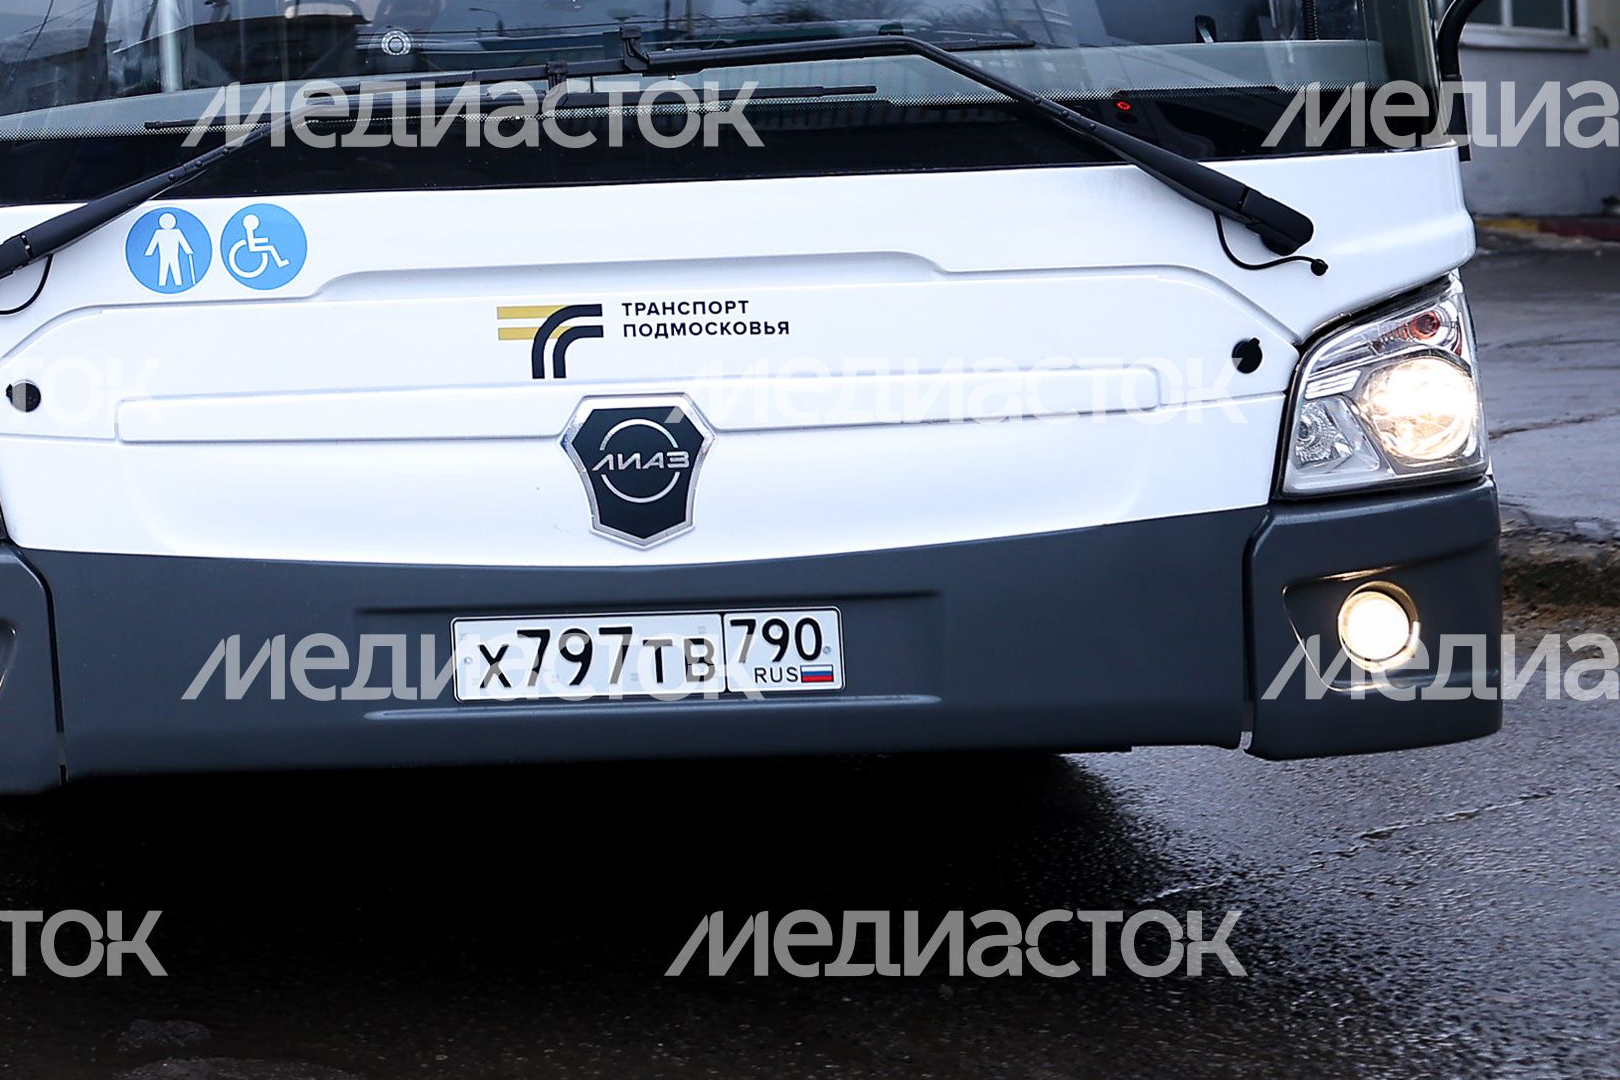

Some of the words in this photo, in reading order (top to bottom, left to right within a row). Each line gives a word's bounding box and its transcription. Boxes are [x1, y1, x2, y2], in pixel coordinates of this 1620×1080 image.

[621, 300, 749, 317] ТРАНСПОРТ
[623, 320, 790, 339] ПОДМОСКОВЬЯ
[592, 451, 690, 472] ЛИАЗ
[730, 617, 823, 664] 790
[754, 666, 798, 684] RUS
